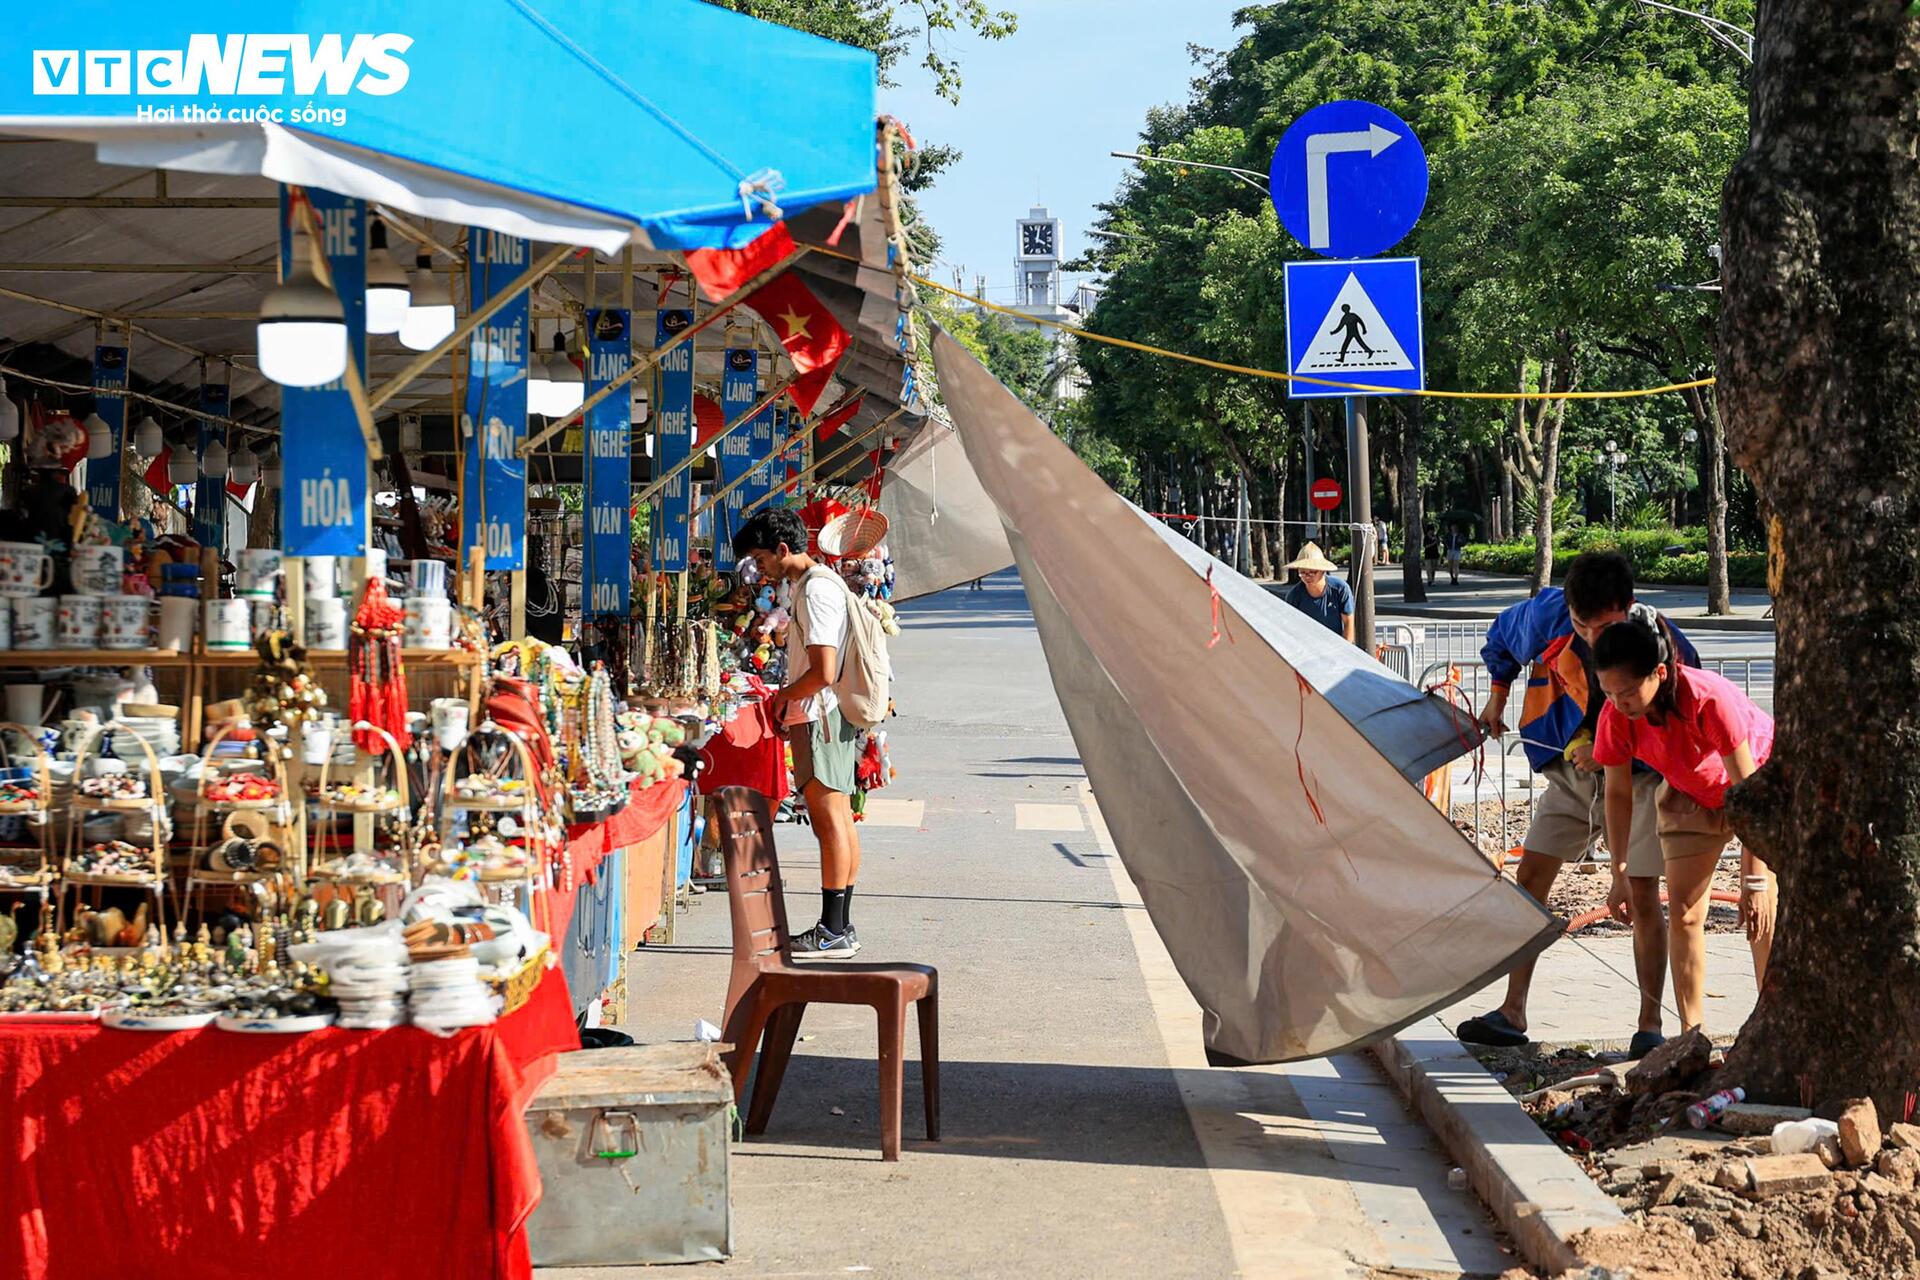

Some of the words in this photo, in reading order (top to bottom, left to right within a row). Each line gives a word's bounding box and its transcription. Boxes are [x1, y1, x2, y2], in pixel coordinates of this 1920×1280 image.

[726, 377, 753, 402] LÀNG
[590, 420, 627, 458] NGHỀ
[722, 430, 750, 456] NGHỀ
[301, 468, 353, 527] HÓA
[592, 501, 622, 534] VĂN
[591, 577, 620, 611] HÓA
